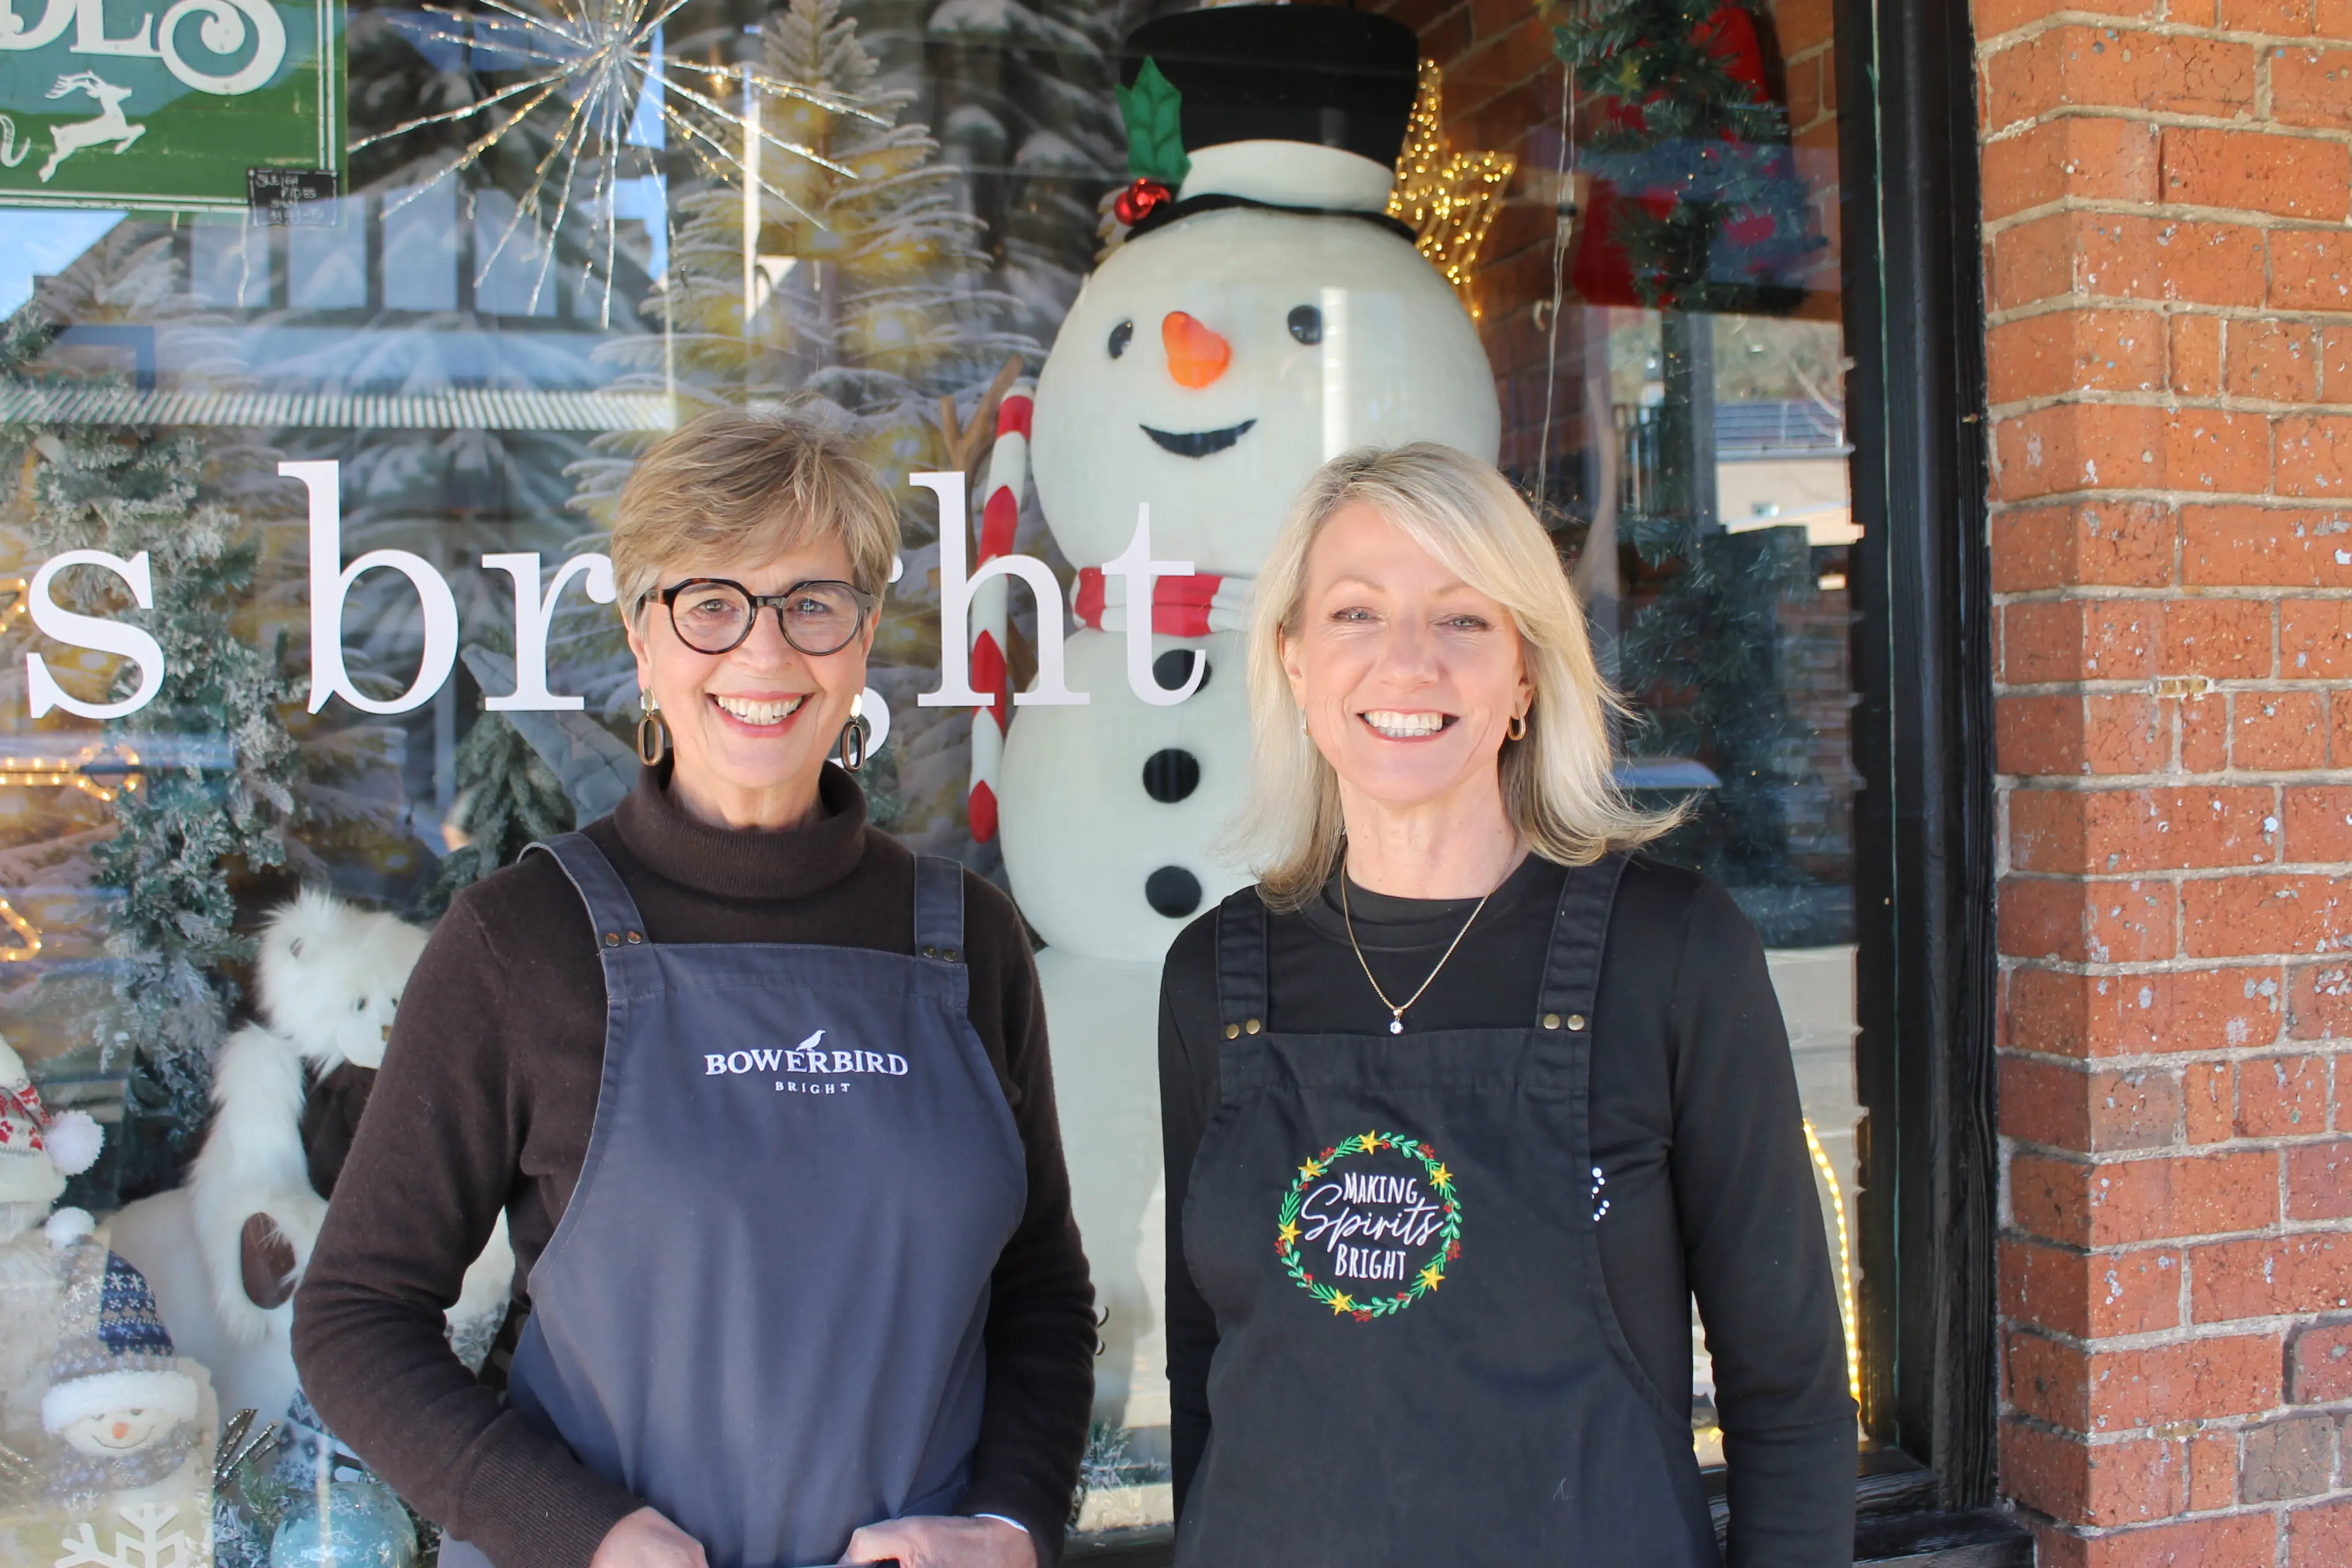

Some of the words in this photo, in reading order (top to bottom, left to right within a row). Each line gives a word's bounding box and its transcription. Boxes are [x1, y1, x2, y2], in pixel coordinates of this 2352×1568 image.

[278, 460, 1207, 769] brht
[704, 1049, 909, 1076] BOWERBIRD
[775, 1081, 851, 1095] BRIGHT
[1343, 1172, 1418, 1204] MAKING
[1301, 1183, 1444, 1253] Spirits
[1335, 1243, 1406, 1280] BRIGHT
